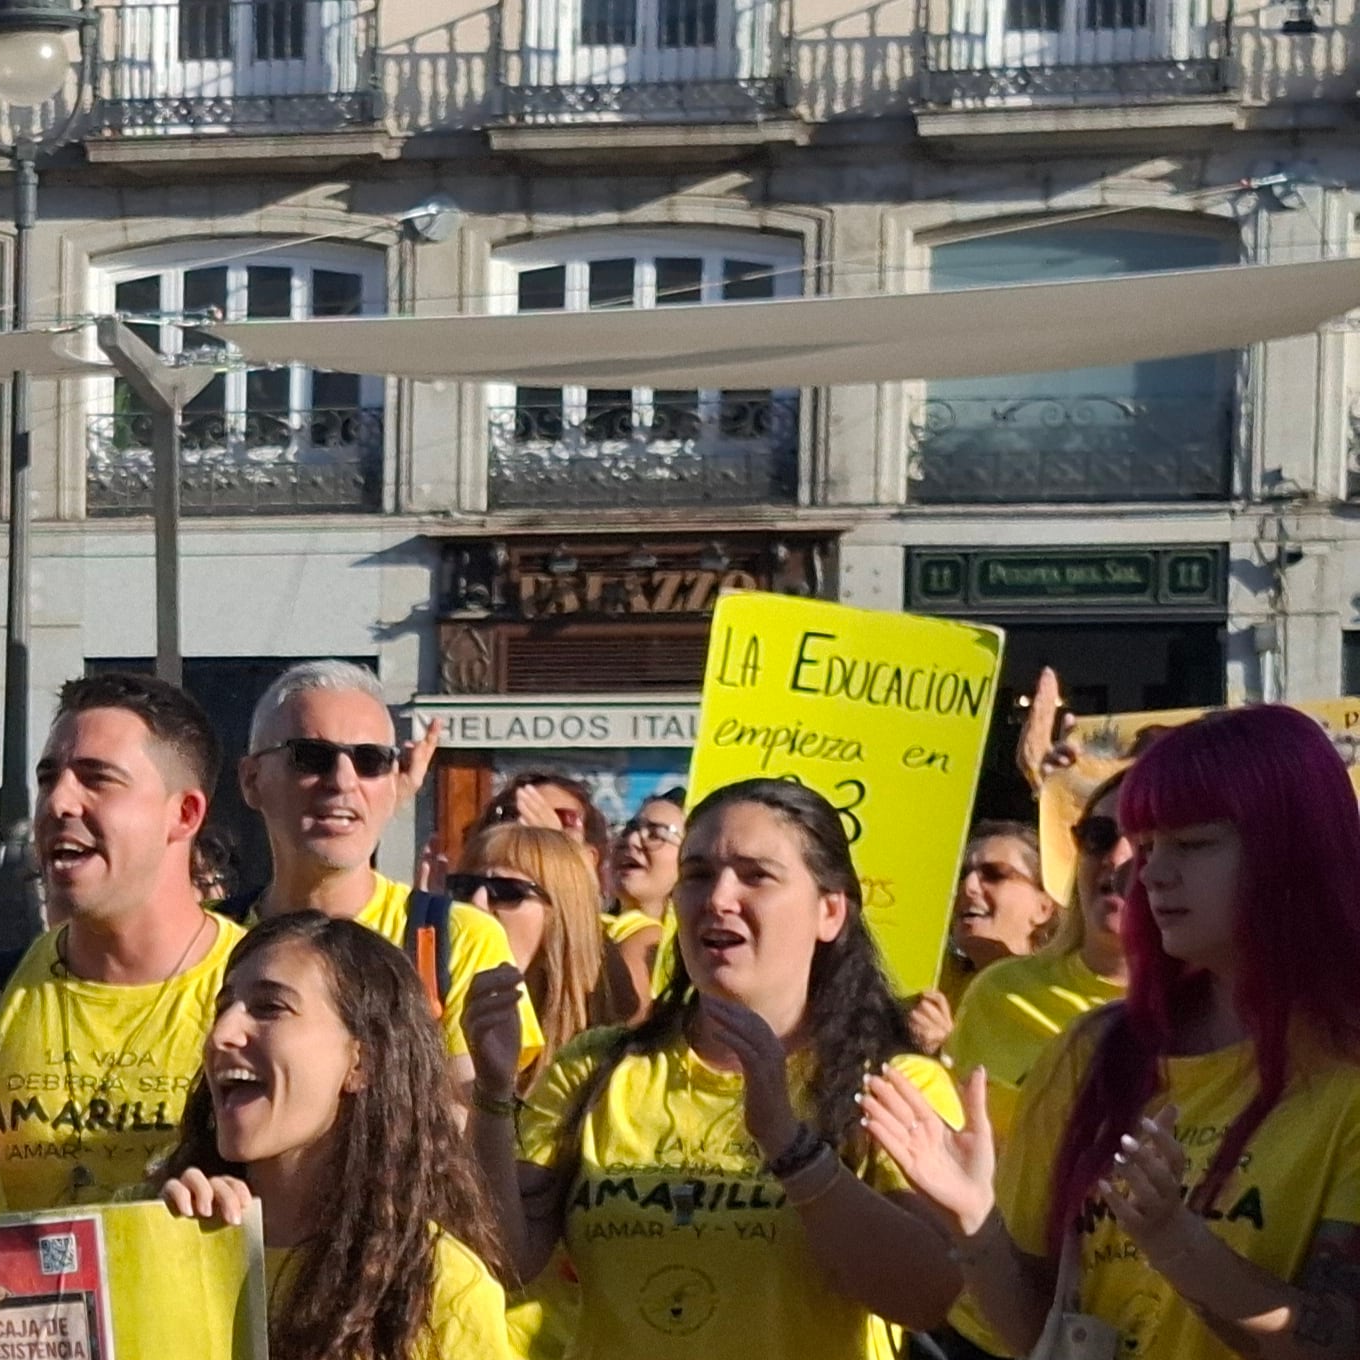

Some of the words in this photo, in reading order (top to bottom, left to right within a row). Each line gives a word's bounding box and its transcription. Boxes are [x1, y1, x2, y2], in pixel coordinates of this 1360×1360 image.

[716, 625, 762, 689] LA
[441, 715, 610, 741] HELADOS
[713, 717, 865, 770] empieza
[901, 745, 951, 775] en
[46, 1050, 79, 1068] LA
[91, 1050, 157, 1068] VIDA
[138, 1074, 191, 1094] SER
[45, 1316, 69, 1338] DE
